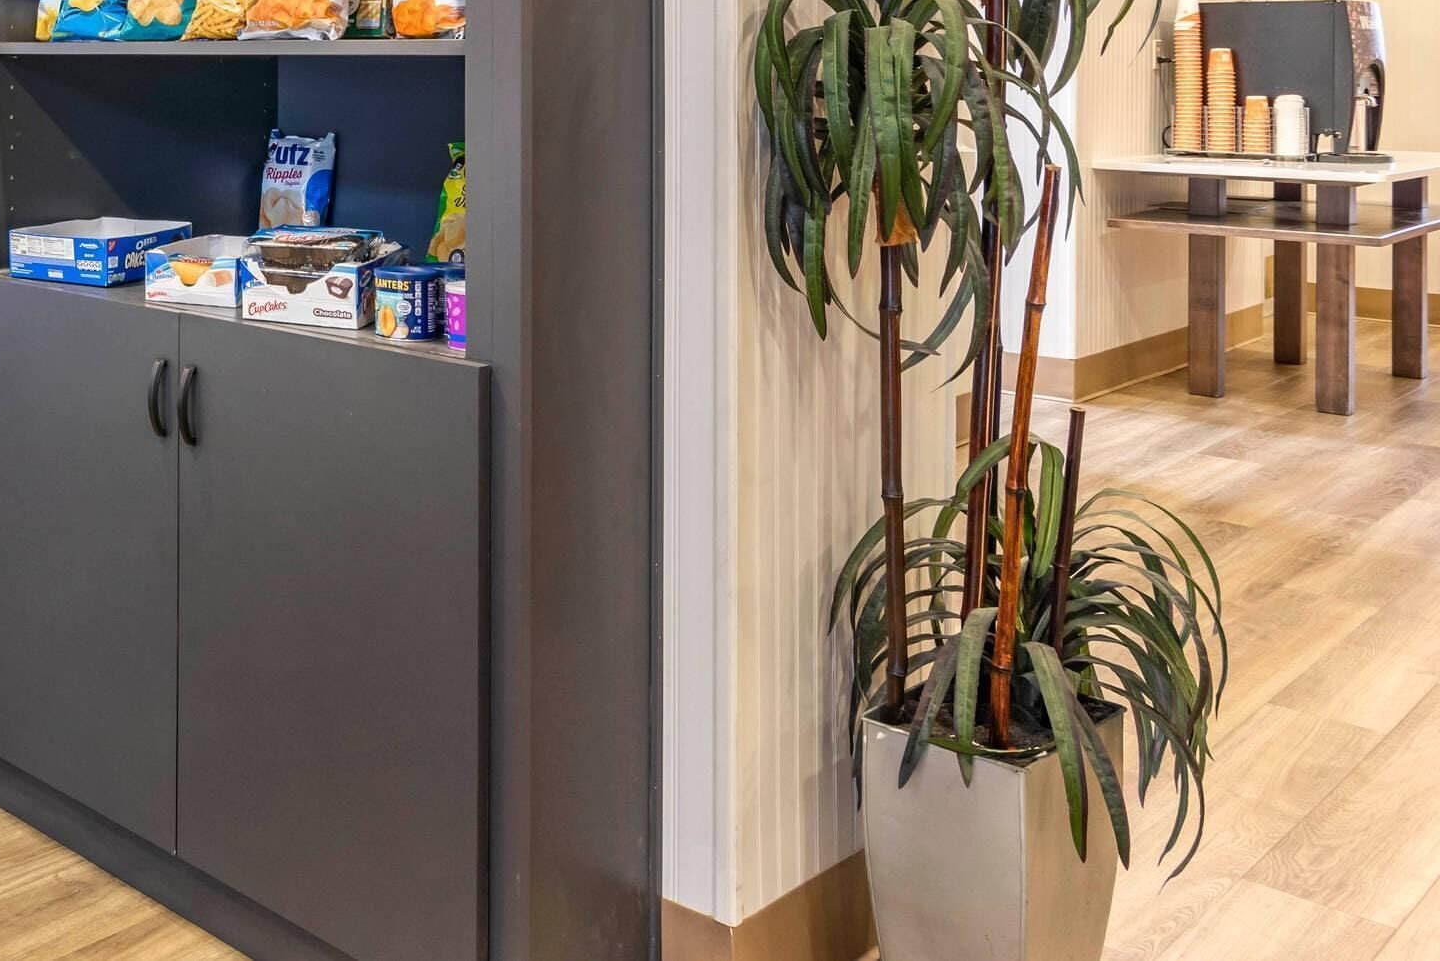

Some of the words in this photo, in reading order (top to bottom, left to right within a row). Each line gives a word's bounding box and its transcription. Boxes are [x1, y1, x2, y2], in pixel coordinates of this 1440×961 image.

[266, 167, 303, 184] Ripples
[248, 300, 288, 317] CupCakes
[313, 308, 352, 320] Chocolate
